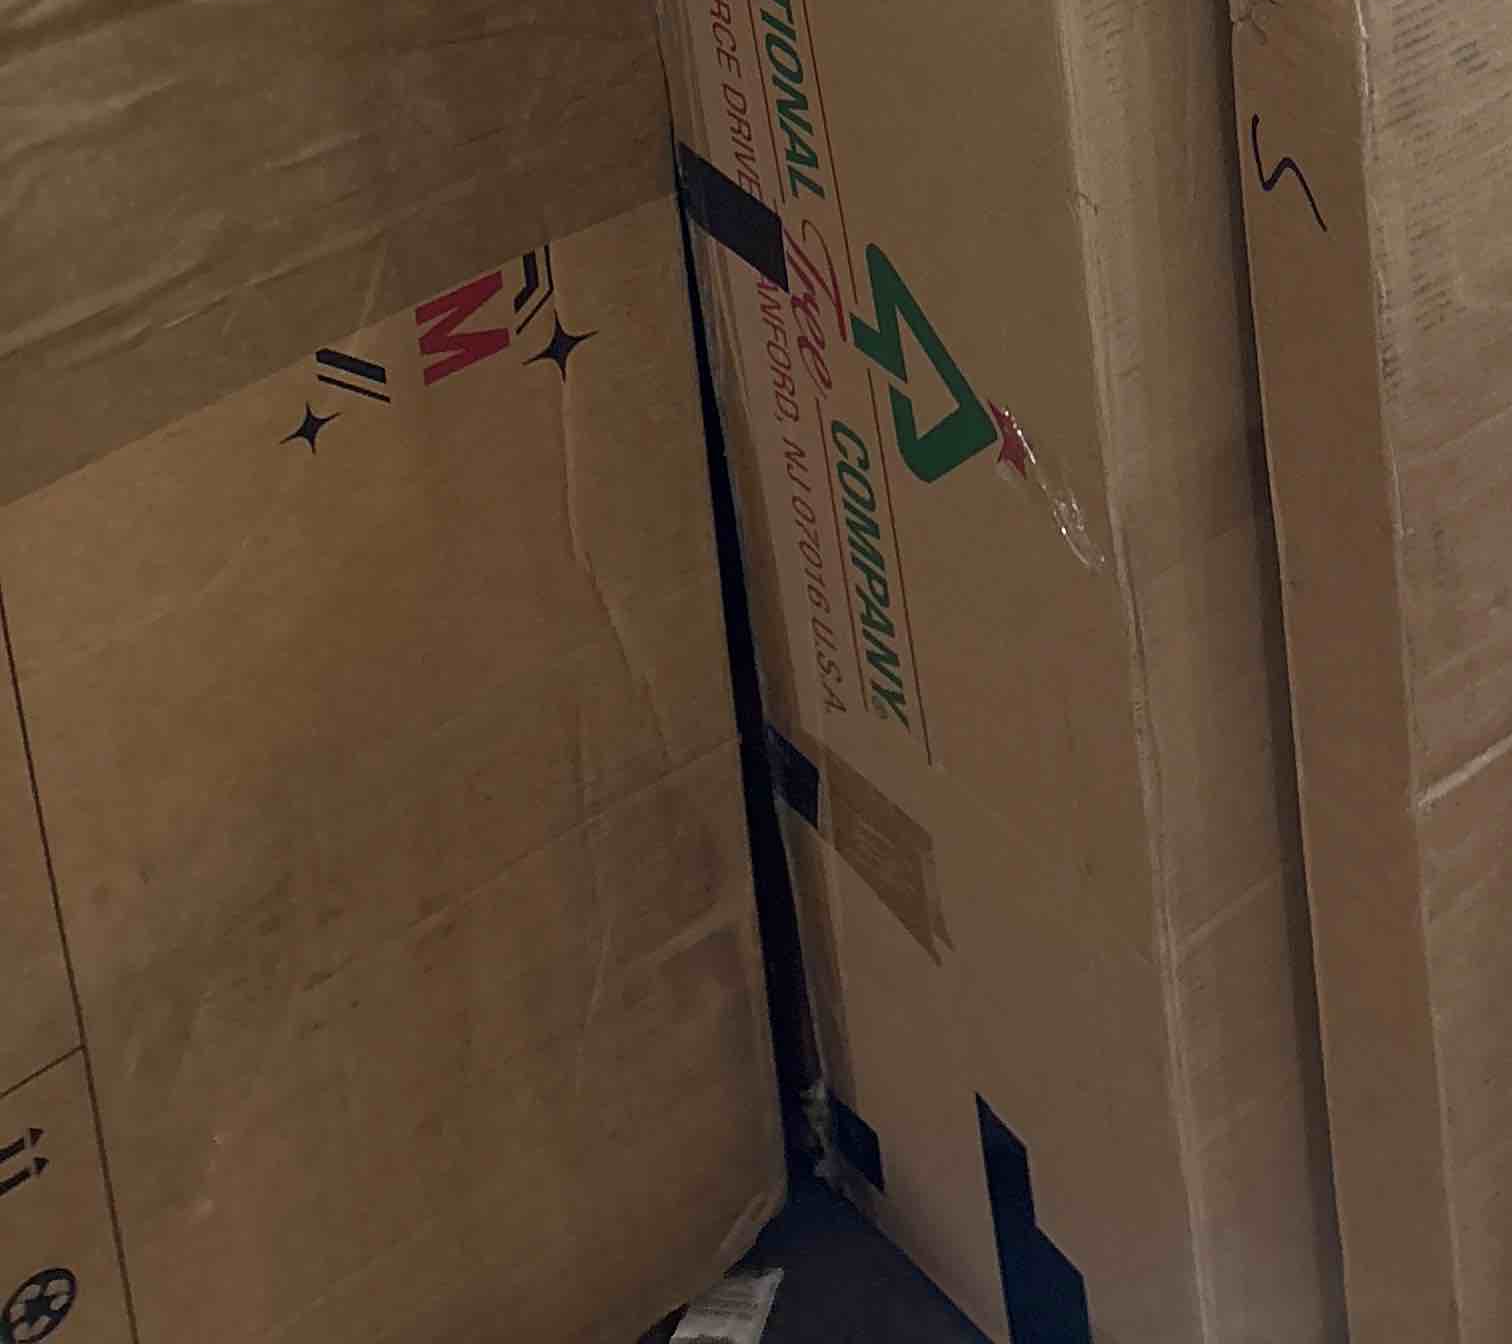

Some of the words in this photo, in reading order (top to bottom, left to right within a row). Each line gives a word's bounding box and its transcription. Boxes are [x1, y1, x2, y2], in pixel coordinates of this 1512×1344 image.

[722, 82, 764, 200] DRIVE
[757, 274, 801, 424] ANFORD,
[782, 219, 848, 392] Tree
[783, 437, 811, 492] NJ
[792, 496, 831, 613] 07016
